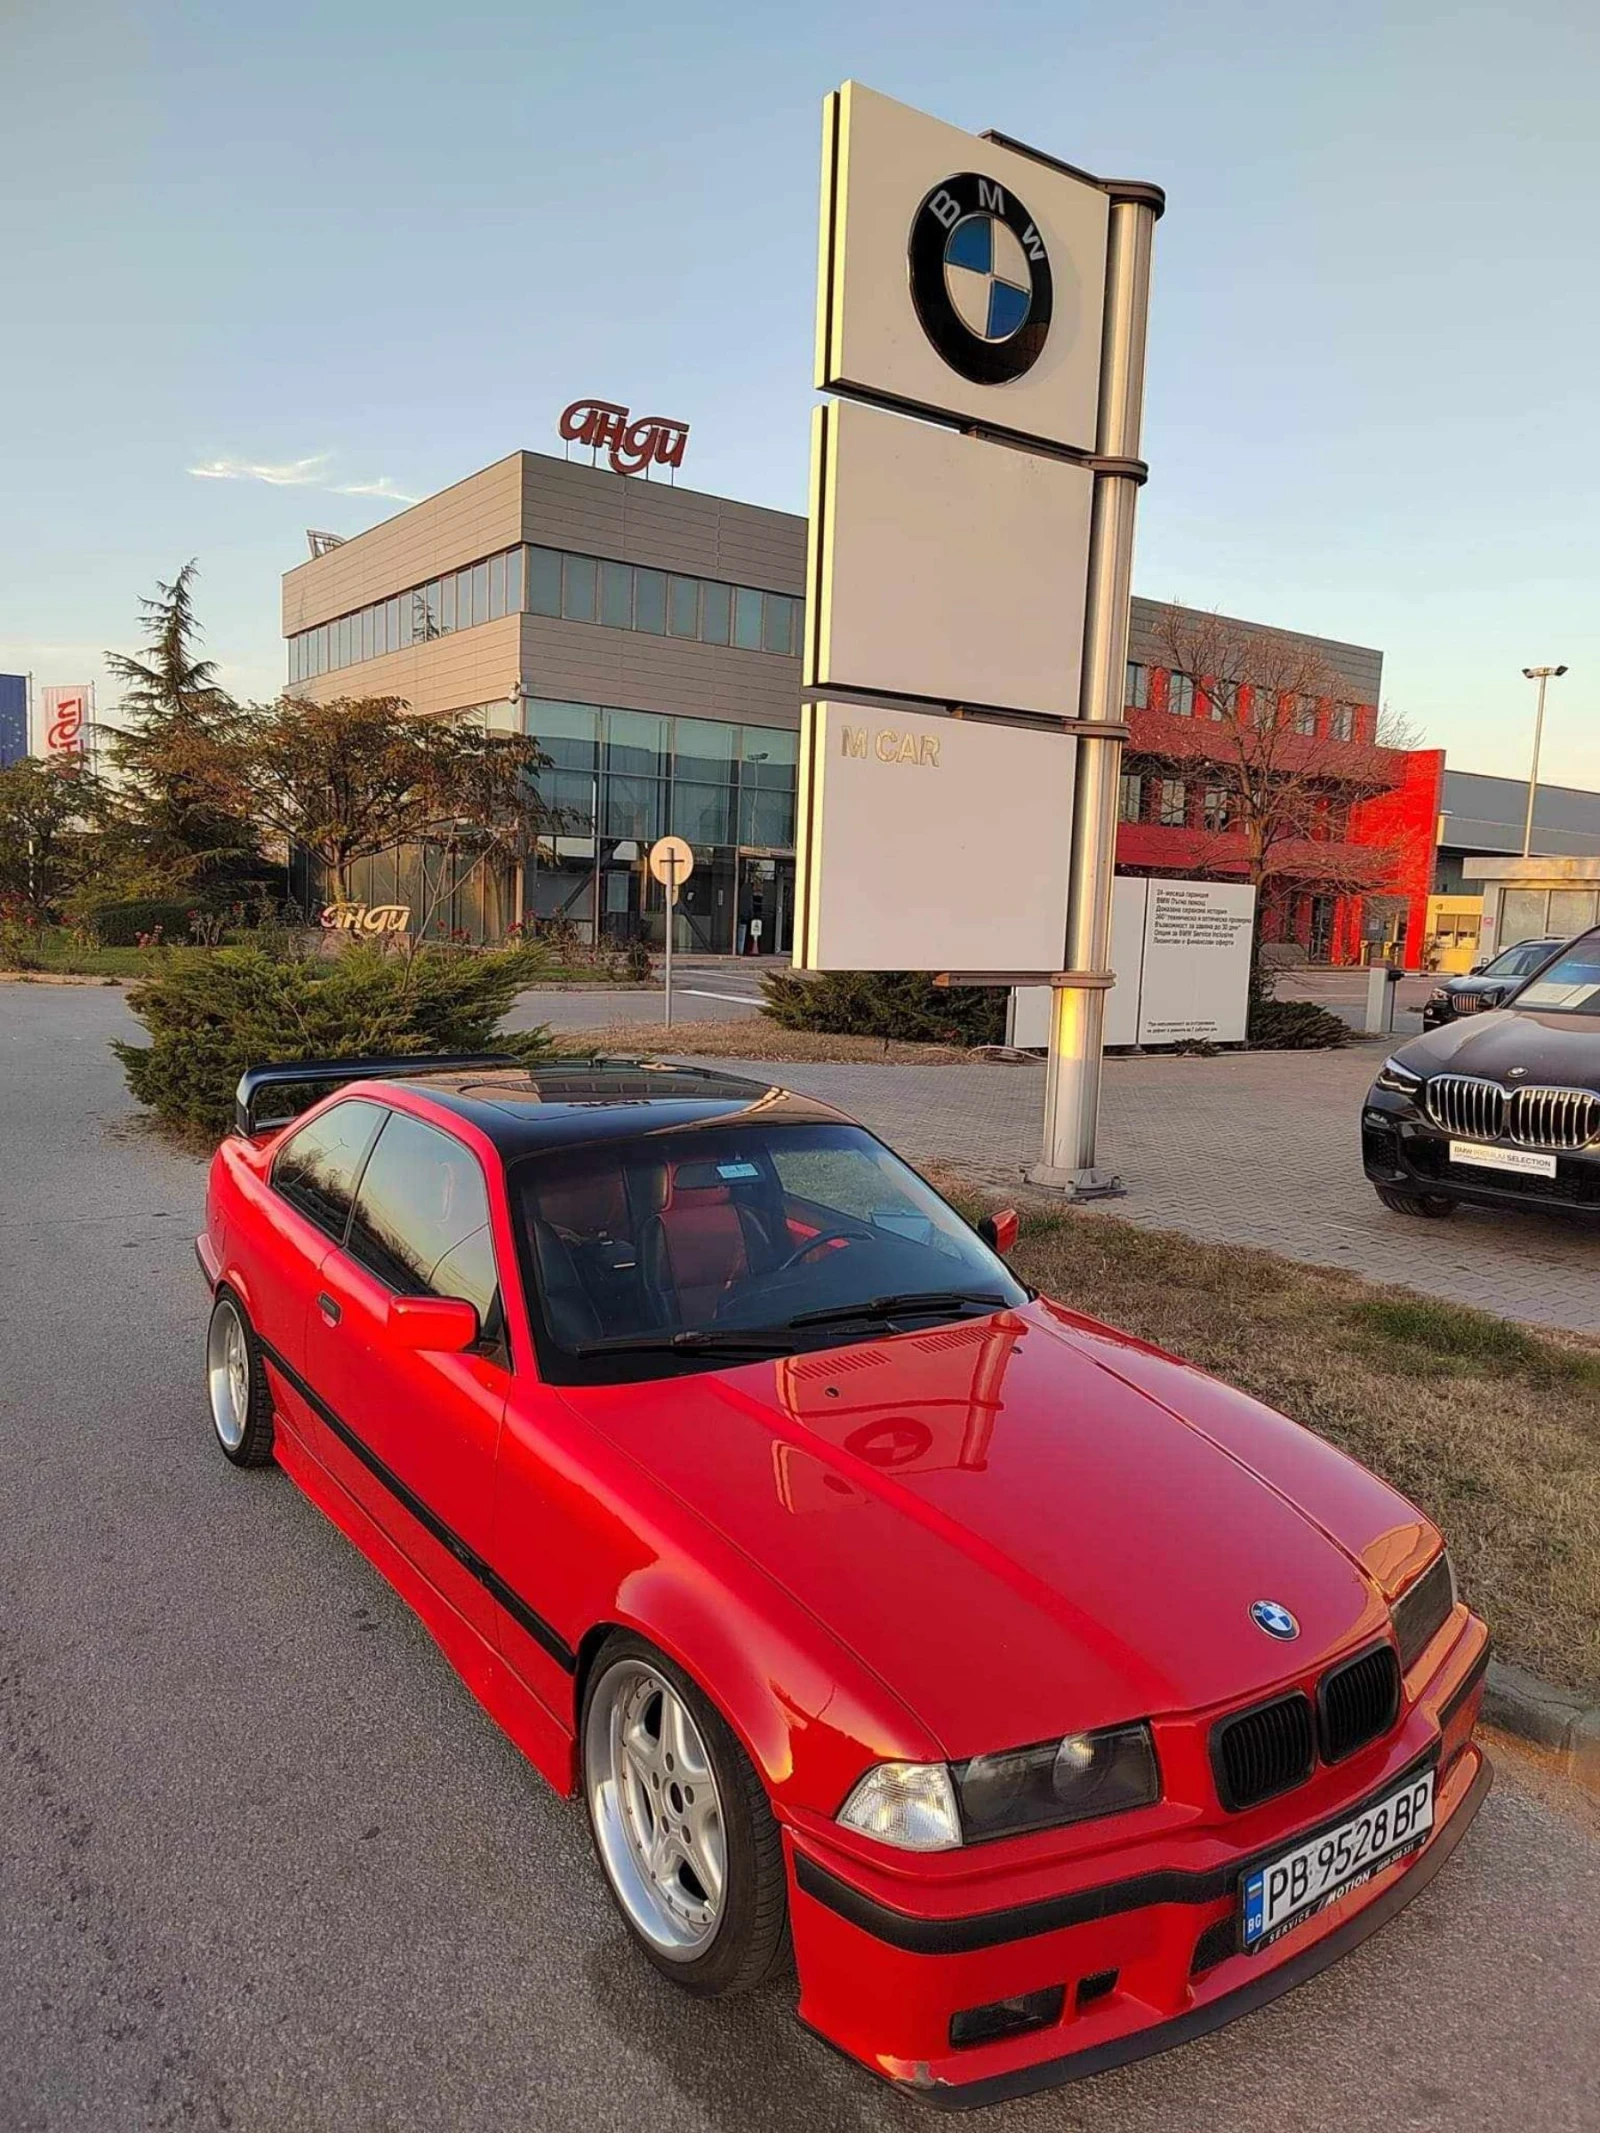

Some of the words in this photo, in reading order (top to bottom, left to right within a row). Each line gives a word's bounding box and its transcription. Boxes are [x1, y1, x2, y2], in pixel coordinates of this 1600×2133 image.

[928, 179, 1045, 262] BMW
[841, 725, 868, 760] M
[875, 728, 940, 768] CAR
[1506, 1154, 1551, 1167] SELECTION
[1318, 1808, 1389, 1889] 9528
[1392, 1782, 1428, 1842] BP
[1247, 1912, 1262, 1934] BG
[1268, 1909, 1311, 1944] SERVICE
